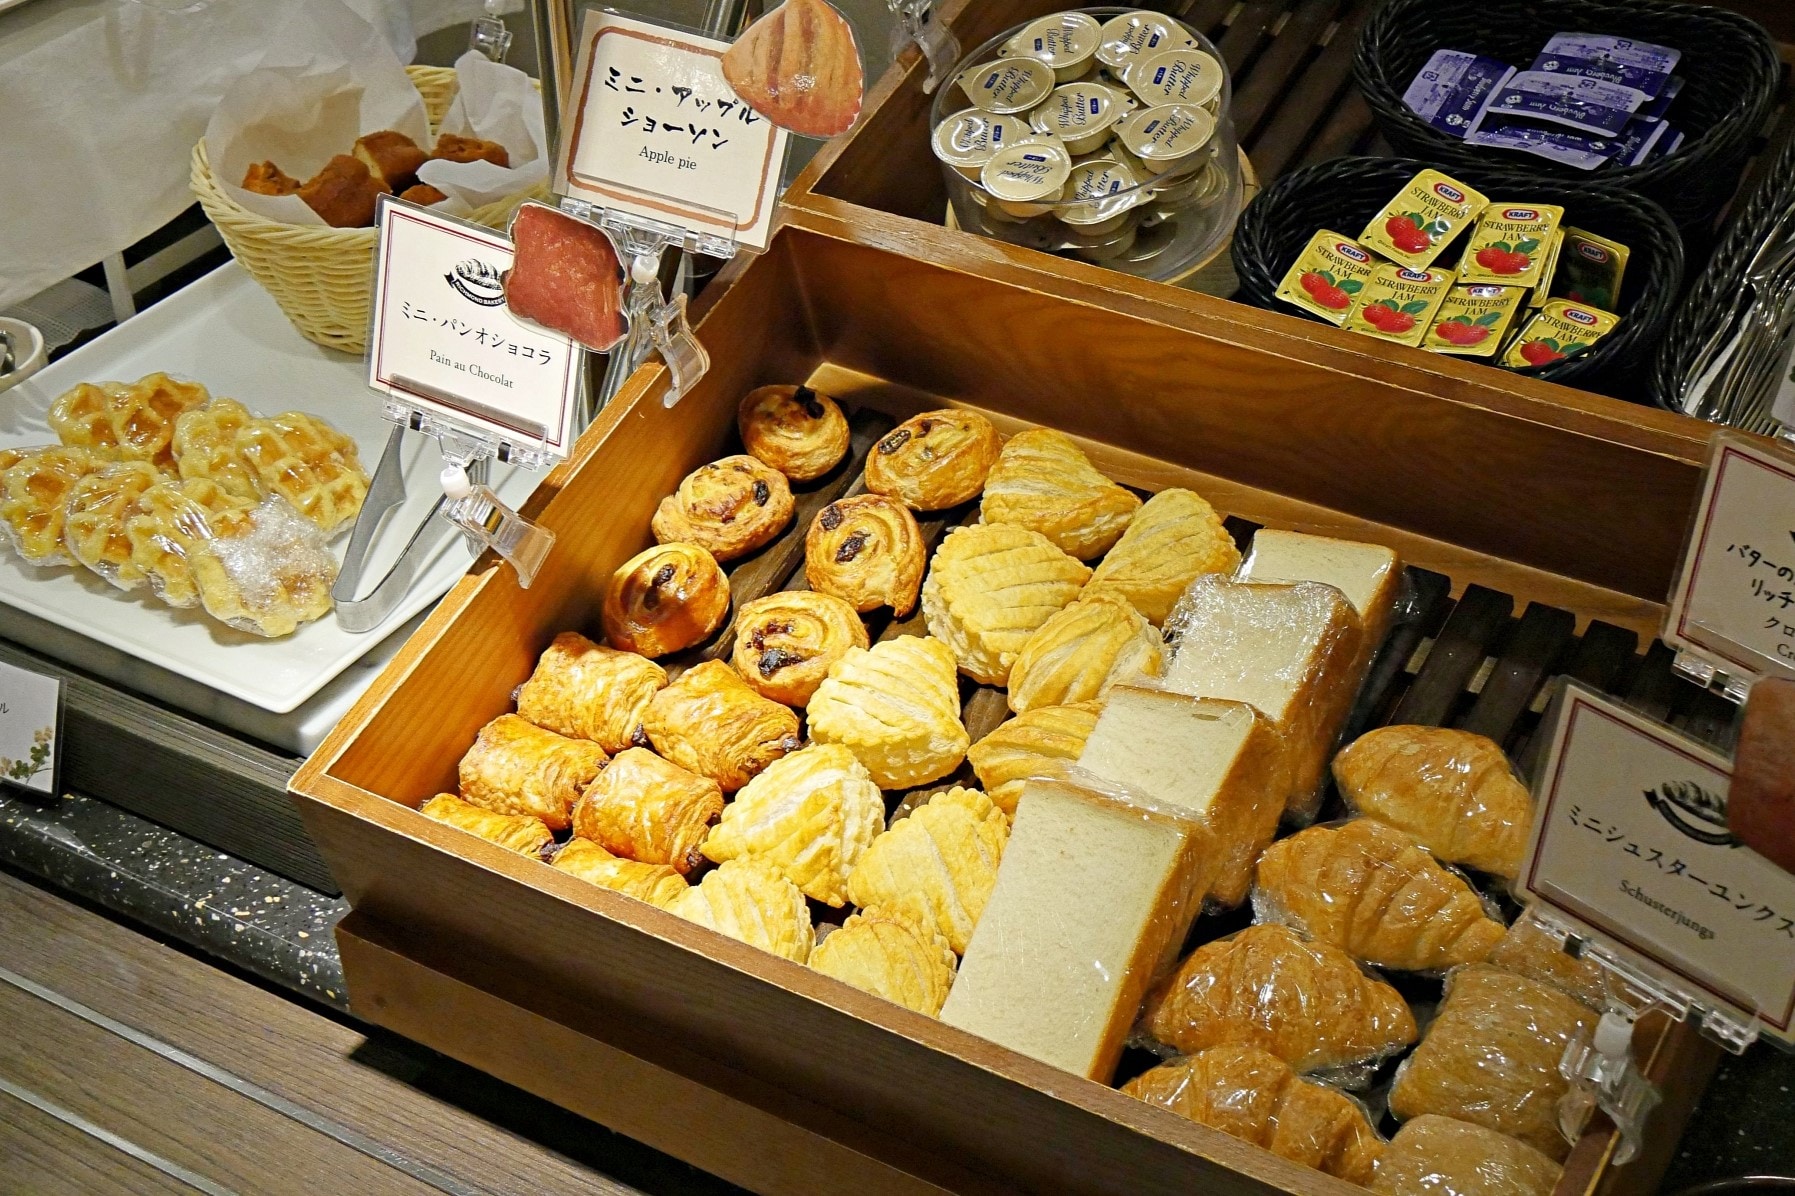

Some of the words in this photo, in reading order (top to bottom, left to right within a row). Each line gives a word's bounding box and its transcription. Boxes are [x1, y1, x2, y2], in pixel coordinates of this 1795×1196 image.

[1129, 24, 1150, 55] Butter
[993, 66, 1019, 99] Butter
[1006, 69, 1033, 103] Whipped
[1165, 59, 1187, 96] Butter
[1178, 63, 1201, 99] Whipped
[1058, 95, 1073, 128] Whipped
[1072, 92, 1087, 126] Butter
[621, 106, 729, 149] ショーソン
[1151, 114, 1182, 144] Butter
[1164, 117, 1195, 148] Whipped
[638, 145, 675, 166] Apple
[676, 153, 698, 170] pie
[1005, 160, 1053, 175] Butter
[996, 169, 1045, 185] Whipped
[1411, 186, 1468, 220] STRAWBERRY
[1438, 185, 1461, 201] KRAFT
[1420, 206, 1444, 220] JAM
[1508, 211, 1533, 219] KRAFT
[1482, 220, 1550, 233] STRAWBERRY
[1501, 232, 1525, 242] JAM
[1315, 245, 1372, 277] STRAWBERR
[1340, 246, 1366, 261] KRAFT
[1583, 246, 1604, 259] KRAFT
[1328, 263, 1353, 280] JAM
[1401, 270, 1427, 280] KRAFT
[1375, 277, 1441, 295] STRAWBERRY
[1391, 290, 1416, 302] JAM
[1447, 296, 1514, 308] STRAWBERRY
[1464, 307, 1488, 316] JAM
[1542, 314, 1604, 338] STRAWBERRY
[1568, 310, 1593, 323] KRAFT
[400, 300, 552, 367] ミニ・パンオショコラ
[1553, 330, 1578, 344] JAM
[429, 349, 451, 367] Pain
[454, 360, 466, 372] au
[469, 364, 515, 390] Chocolat
[1726, 544, 1795, 582] バターの
[1751, 578, 1795, 609] リッチ
[1568, 804, 1795, 939] ミニシュスターユンクス
